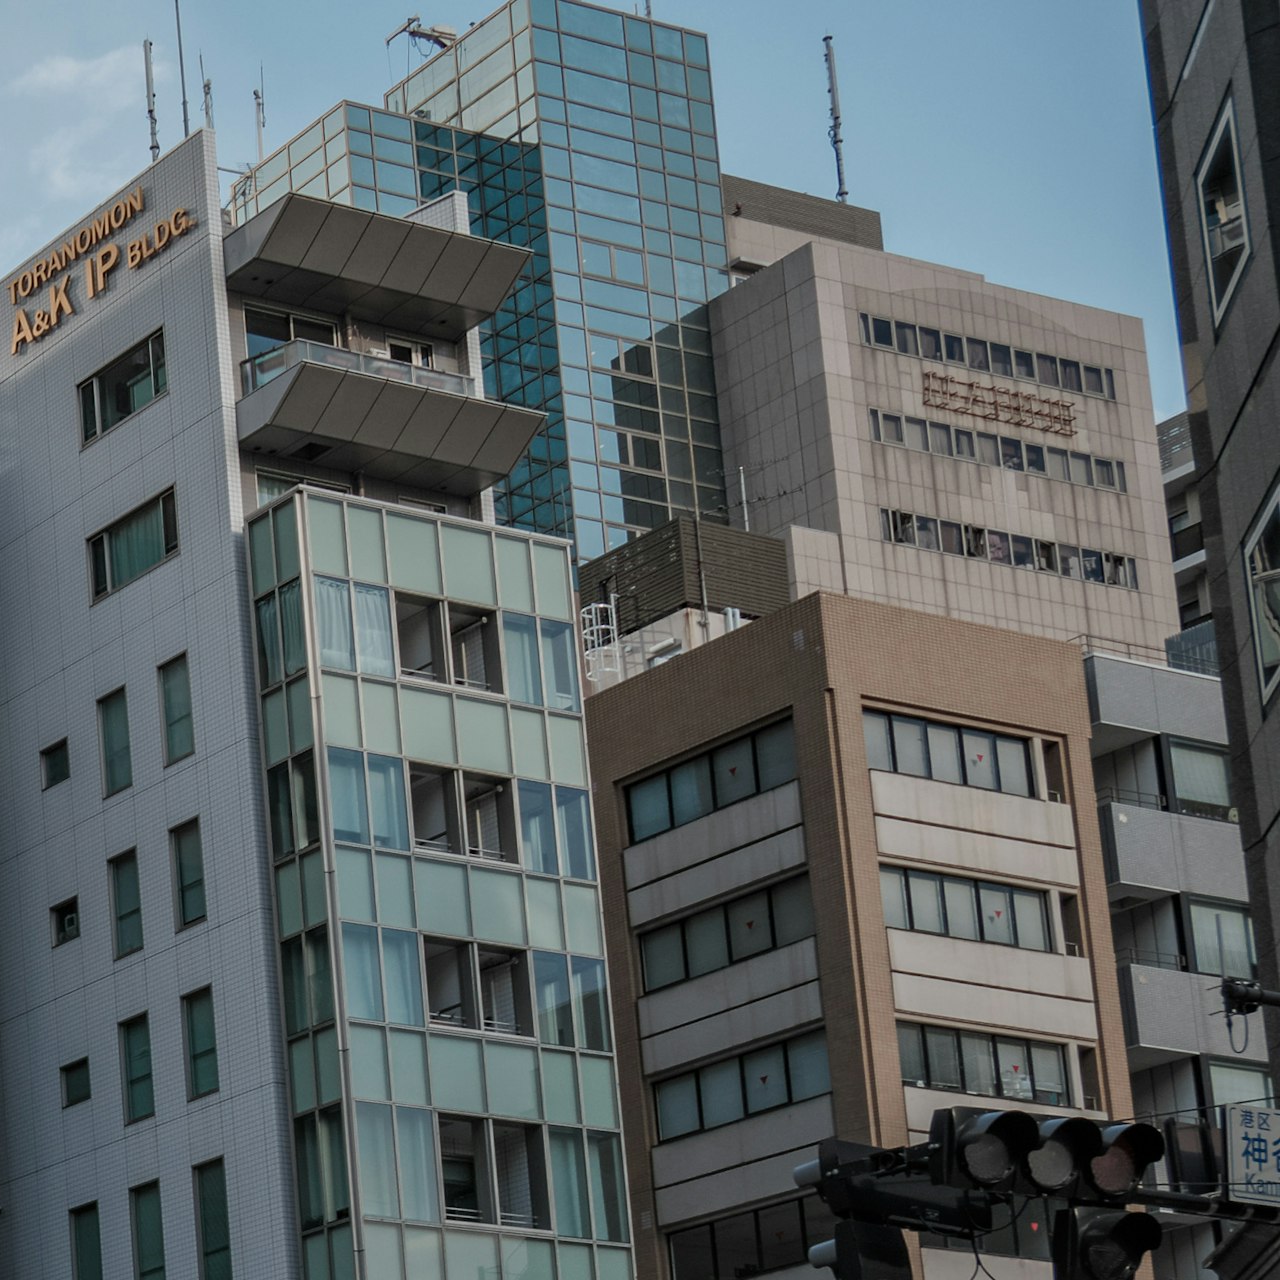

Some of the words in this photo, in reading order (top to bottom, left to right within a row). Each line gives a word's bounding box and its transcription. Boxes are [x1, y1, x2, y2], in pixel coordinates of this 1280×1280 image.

[6, 185, 145, 305] TORANOMON
[10, 274, 75, 355] A&K
[84, 243, 120, 299] IP
[126, 207, 197, 270] BLDG.
[1240, 1109, 1271, 1131] 港区
